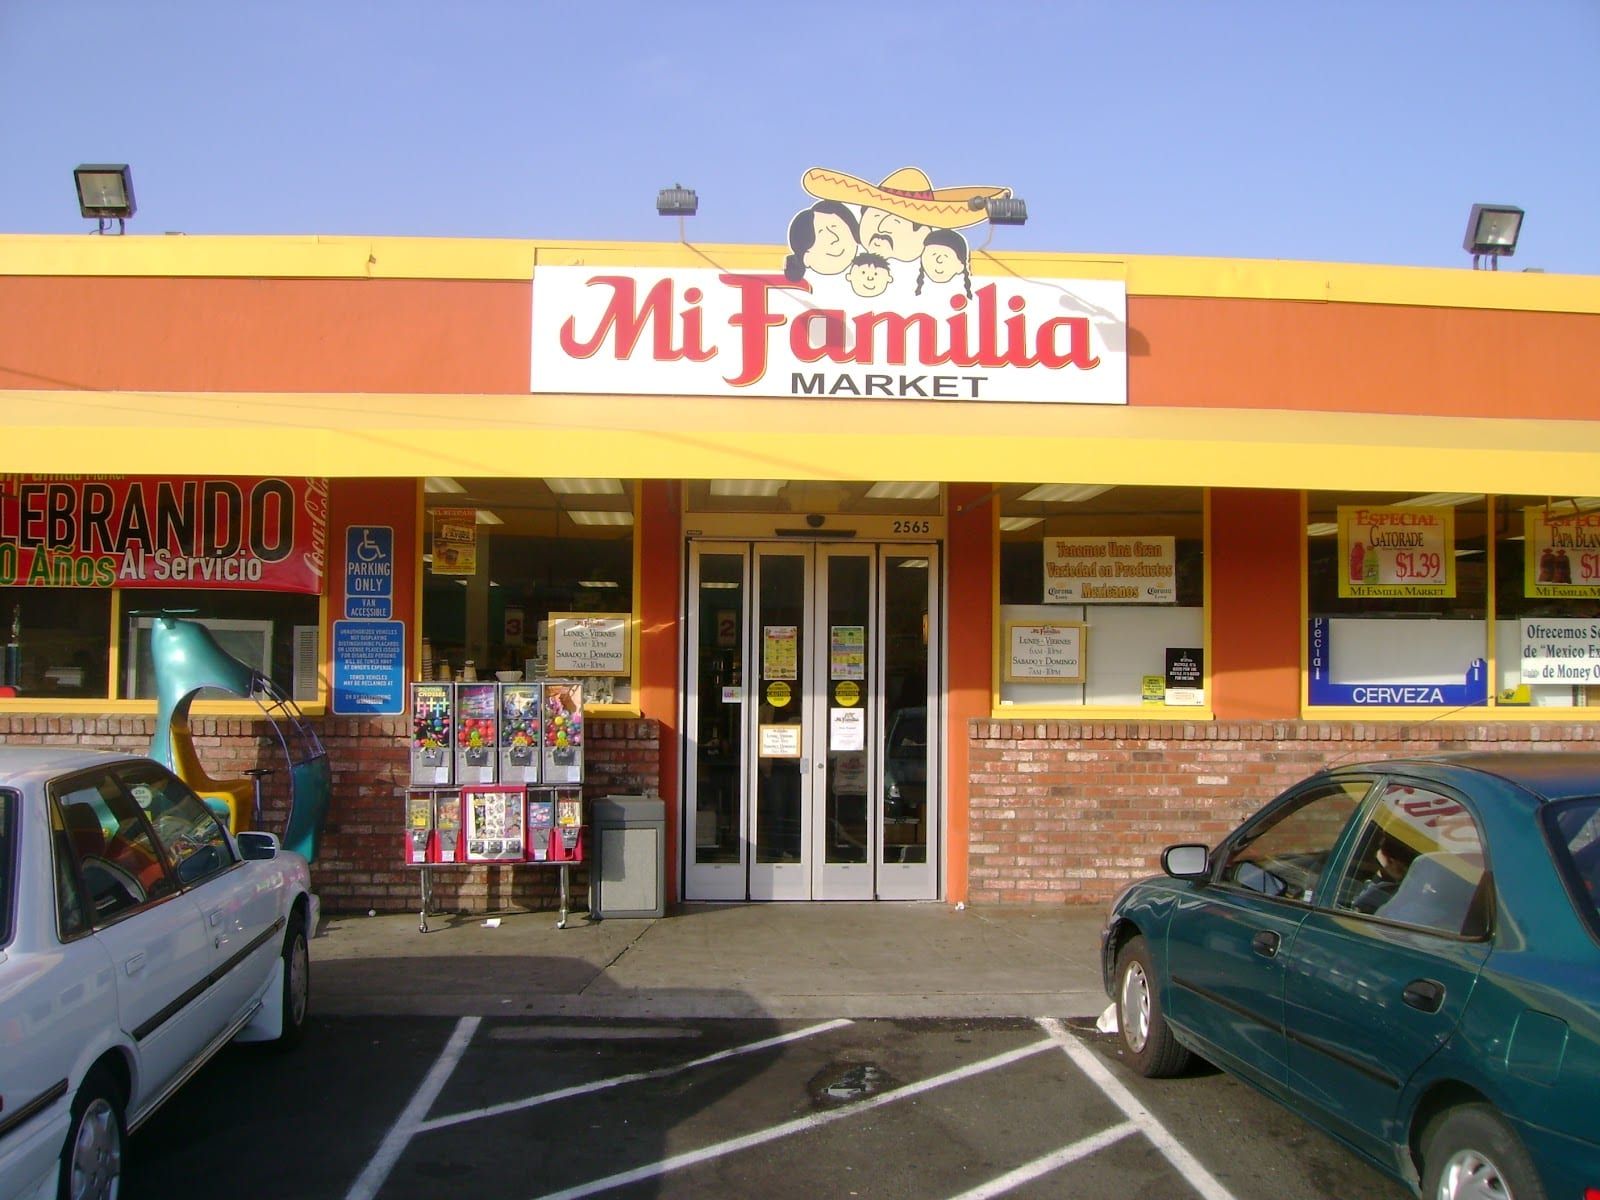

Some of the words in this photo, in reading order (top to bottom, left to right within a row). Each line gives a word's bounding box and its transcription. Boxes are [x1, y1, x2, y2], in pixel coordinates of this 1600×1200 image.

[559, 275, 718, 362] Mi
[719, 273, 1100, 387] Familia
[790, 372, 988, 399] MARKET
[1356, 510, 1439, 526] ESPECIAL
[893, 521, 929, 534] 2565
[1370, 525, 1424, 547] GATORADE
[1552, 527, 1573, 547] PAPA
[1056, 541, 1106, 558] Tenemos
[1108, 542, 1132, 557] Una
[1133, 541, 1162, 557] Gran
[27, 543, 116, 587] Años
[119, 547, 146, 580] Al
[153, 547, 262, 581] Servicio
[348, 562, 390, 576] PARKING
[1046, 562, 1097, 577] Variedad
[1098, 565, 1113, 577] en
[1115, 562, 1172, 577] Productos
[1395, 552, 1440, 581] $1.39
[355, 577, 382, 592] ONLY
[1081, 582, 1138, 598] Mexicanos
[1536, 587, 1550, 596] MI
[1553, 587, 1588, 596] FAMILIA
[350, 608, 386, 616] ACCESSIBLE
[507, 619, 521, 636] 3
[719, 620, 734, 638] 2
[1527, 625, 1587, 638] Ofrecemos
[1524, 645, 1537, 658] de
[1542, 665, 1554, 678] de
[1557, 664, 1590, 680] Money
[1353, 688, 1444, 703] CERVEZA
